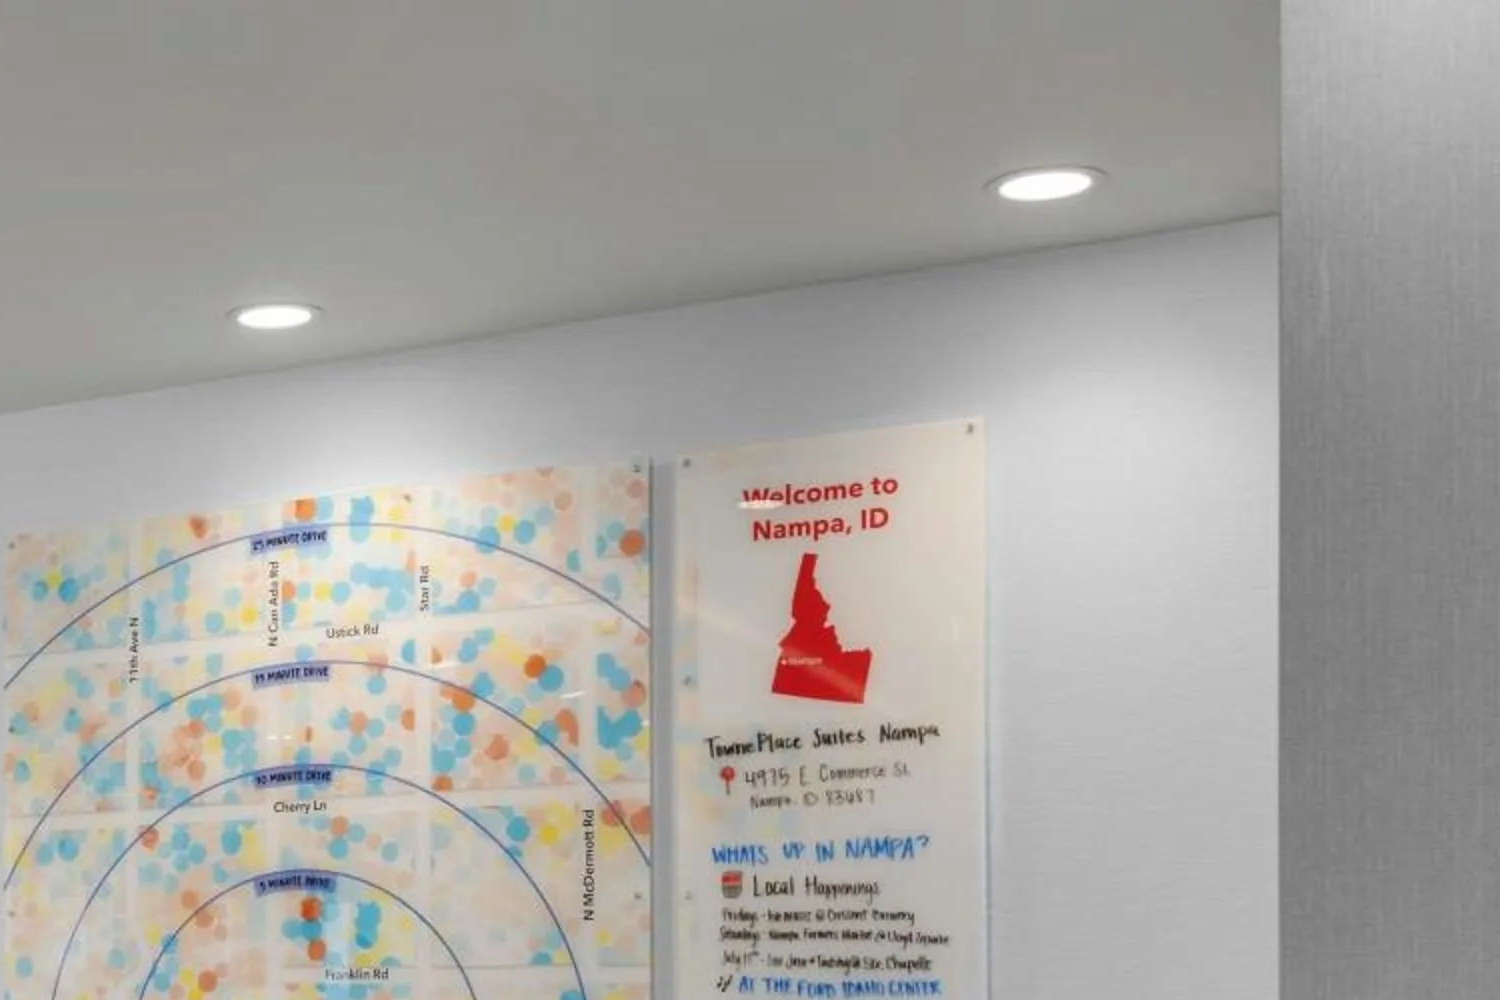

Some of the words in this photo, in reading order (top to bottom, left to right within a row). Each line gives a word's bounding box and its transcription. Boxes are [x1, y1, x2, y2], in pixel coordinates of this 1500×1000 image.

[742, 481, 864, 505] Welcome
[871, 477, 898, 496] to
[753, 517, 852, 541] Nampa,
[861, 507, 889, 530] ID
[301, 529, 327, 542] DRIVE
[268, 561, 280, 578] Rd
[420, 565, 430, 583] Rd
[268, 581, 279, 609] Ada
[420, 587, 430, 612] Star
[129, 617, 140, 628] N
[326, 626, 360, 639] Ustick
[363, 624, 379, 635] Rd
[129, 630, 140, 653] Ave
[268, 637, 279, 647] N
[129, 654, 140, 683] 11th
[303, 665, 329, 678] DRIVE
[812, 728, 866, 748] Suites
[879, 723, 941, 746] Nampa
[269, 770, 302, 782] MINUTE
[305, 769, 332, 782] DRIVE
[799, 764, 809, 786] E
[819, 762, 886, 783] Commerce
[273, 801, 311, 814] Cherry
[313, 800, 327, 811] Ln
[583, 809, 595, 828] Rd
[783, 841, 806, 861] UP
[816, 840, 835, 862] IN
[846, 834, 930, 862] NAMPA?
[583, 831, 595, 908] McDermott
[753, 876, 795, 898] Local
[805, 876, 880, 904] Happenings
[583, 909, 595, 921] N
[325, 968, 371, 981] Franklin
[373, 967, 389, 979] Rd
[761, 976, 790, 993] THE
